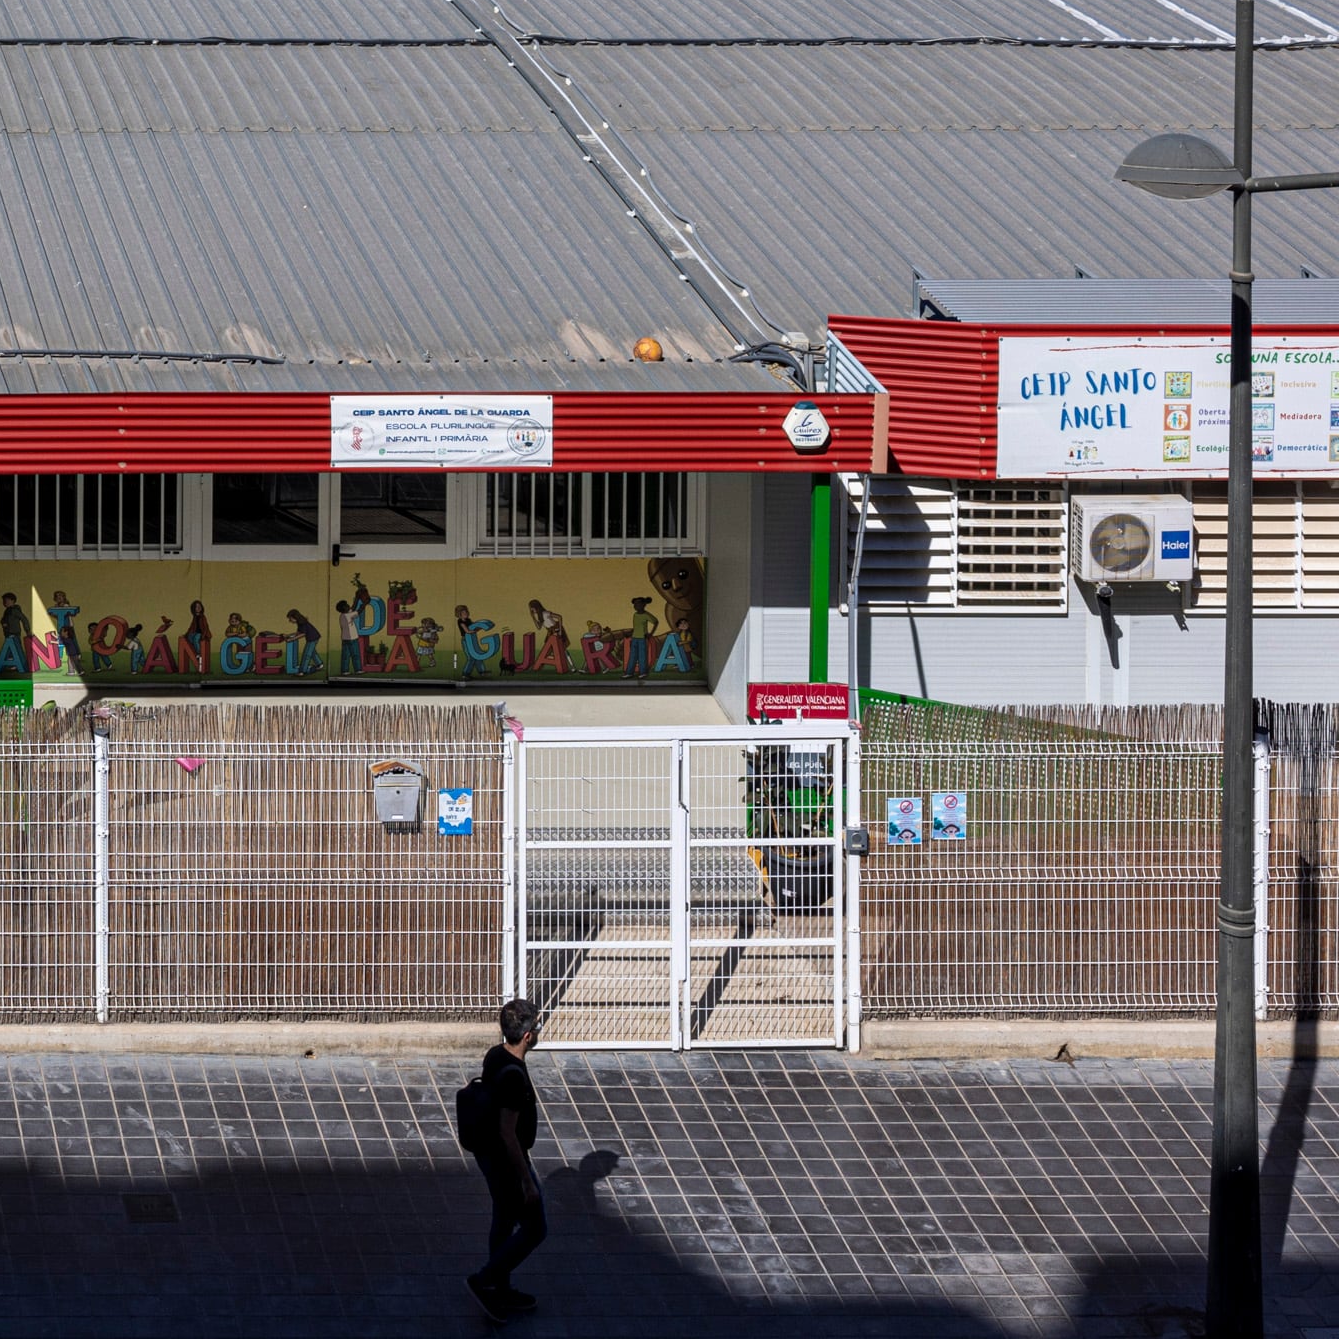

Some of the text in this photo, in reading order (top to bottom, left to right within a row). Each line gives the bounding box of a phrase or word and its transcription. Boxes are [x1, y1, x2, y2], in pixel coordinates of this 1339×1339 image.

[1215, 352, 1232, 364] SO
[1021, 368, 1156, 400] CEIP SANTO
[418, 408, 451, 416] ÁNGEL
[1060, 401, 1132, 431] ÁNGEL
[1198, 408, 1226, 416] Oberta
[1162, 542, 1189, 550] Haier
[764, 694, 845, 705] GENERALITAT VALENCIANA
